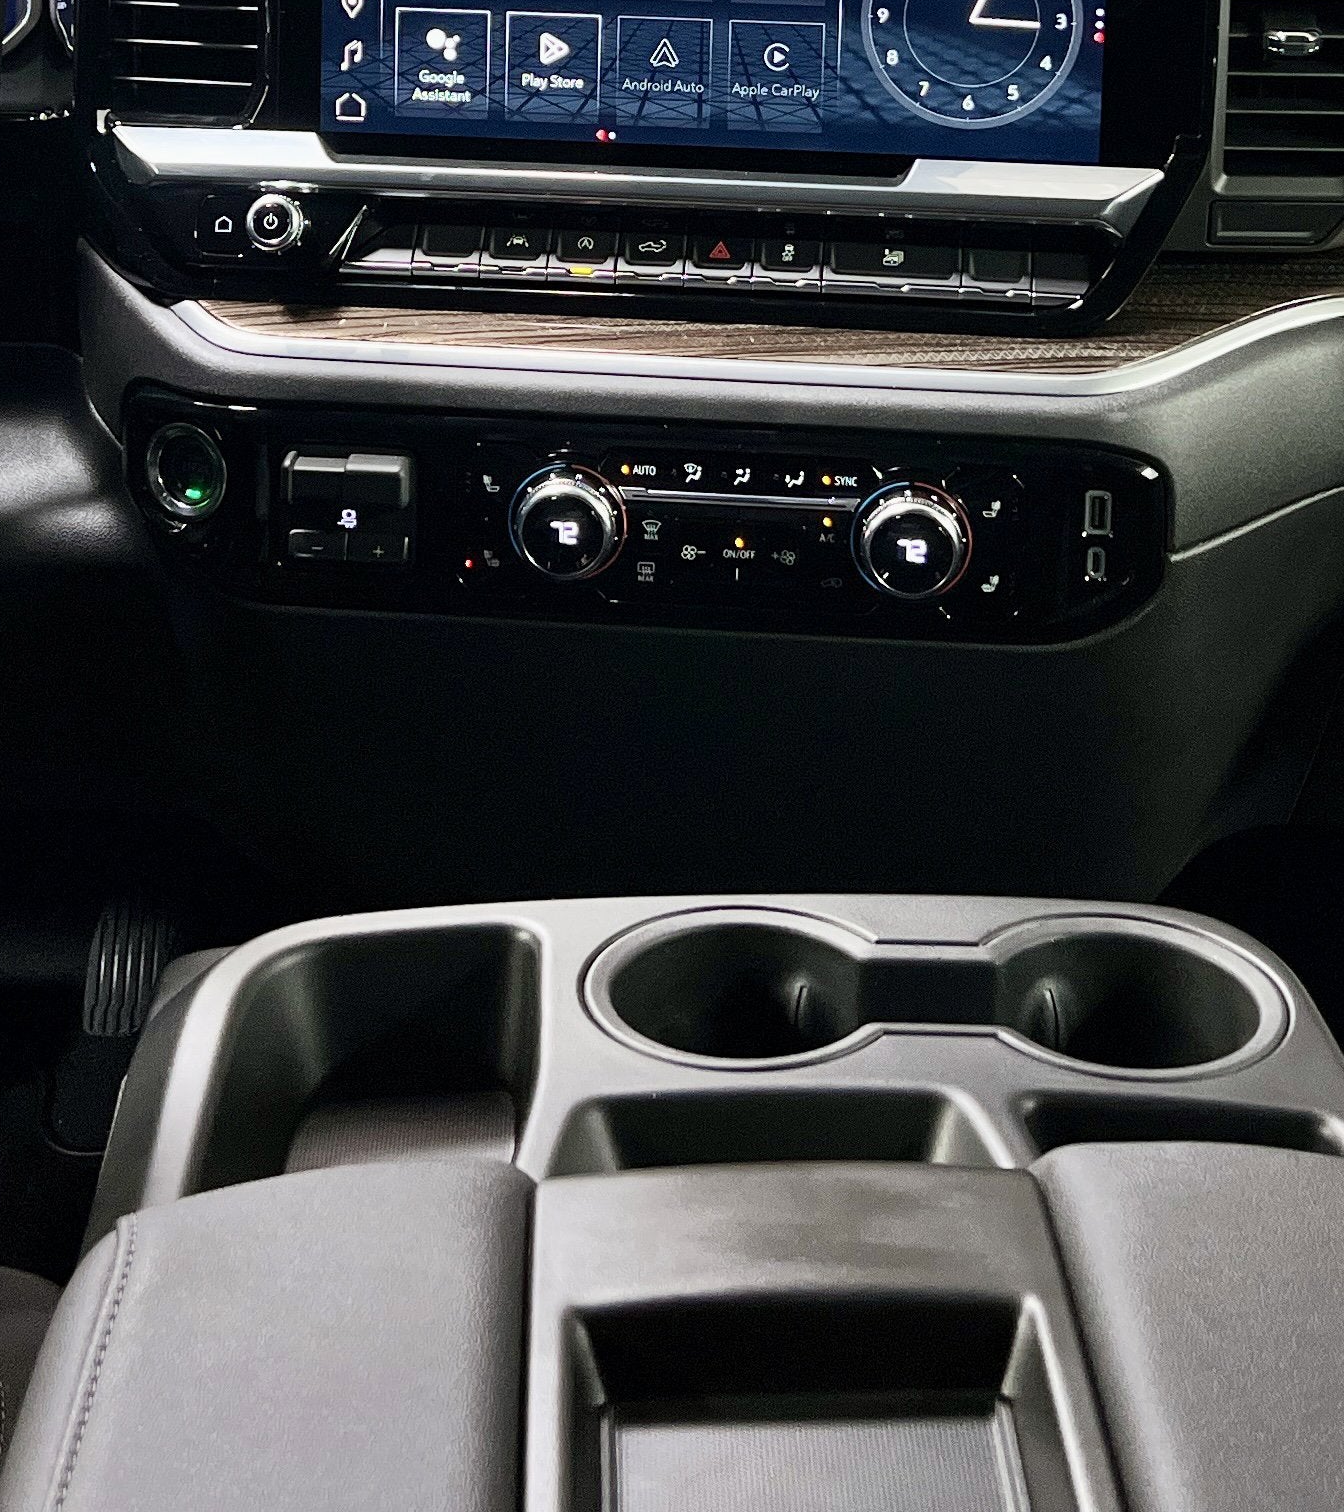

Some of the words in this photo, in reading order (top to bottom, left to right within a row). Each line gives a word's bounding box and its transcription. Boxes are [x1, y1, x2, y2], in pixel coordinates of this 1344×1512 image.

[876, 7, 890, 24] 9
[1054, 13, 1068, 30] 3
[886, 49, 899, 66] 8
[1039, 55, 1052, 71] 4
[419, 69, 465, 87] Google
[522, 73, 548, 90] Play
[550, 74, 584, 89] Store
[622, 78, 672, 92] Android
[674, 80, 704, 93] Auto
[412, 87, 472, 102] Assistant
[732, 82, 768, 98] Apple
[771, 83, 820, 101] CarPlay
[918, 80, 930, 96] 7
[1006, 84, 1020, 101] 5
[962, 95, 975, 110] 6
[633, 466, 656, 476] AUTO
[834, 476, 857, 487] SYNC
[550, 521, 579, 545] 72
[723, 549, 756, 559] ON/OFF
